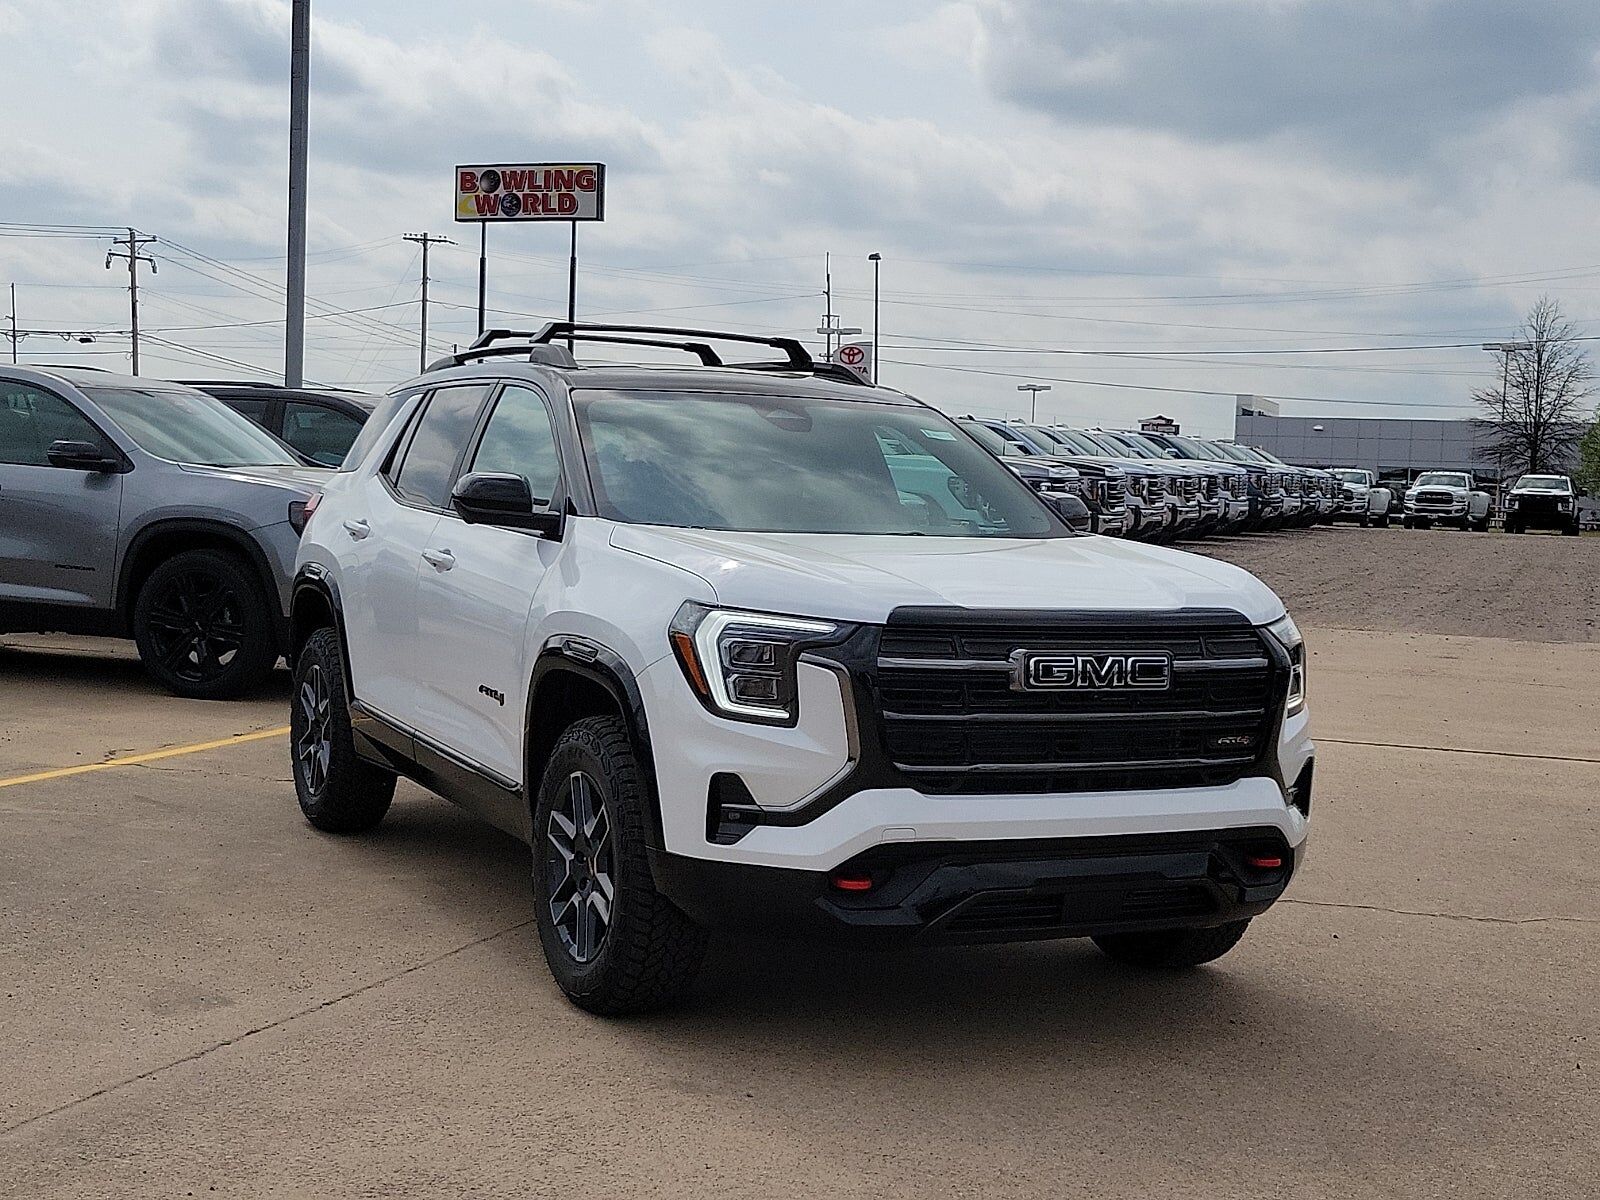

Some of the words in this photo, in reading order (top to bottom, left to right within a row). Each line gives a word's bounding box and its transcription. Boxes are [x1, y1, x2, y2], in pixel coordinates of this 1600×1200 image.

[460, 169, 597, 193] BOWLING
[474, 192, 579, 217] WORLD
[1029, 656, 1172, 690] GMC
